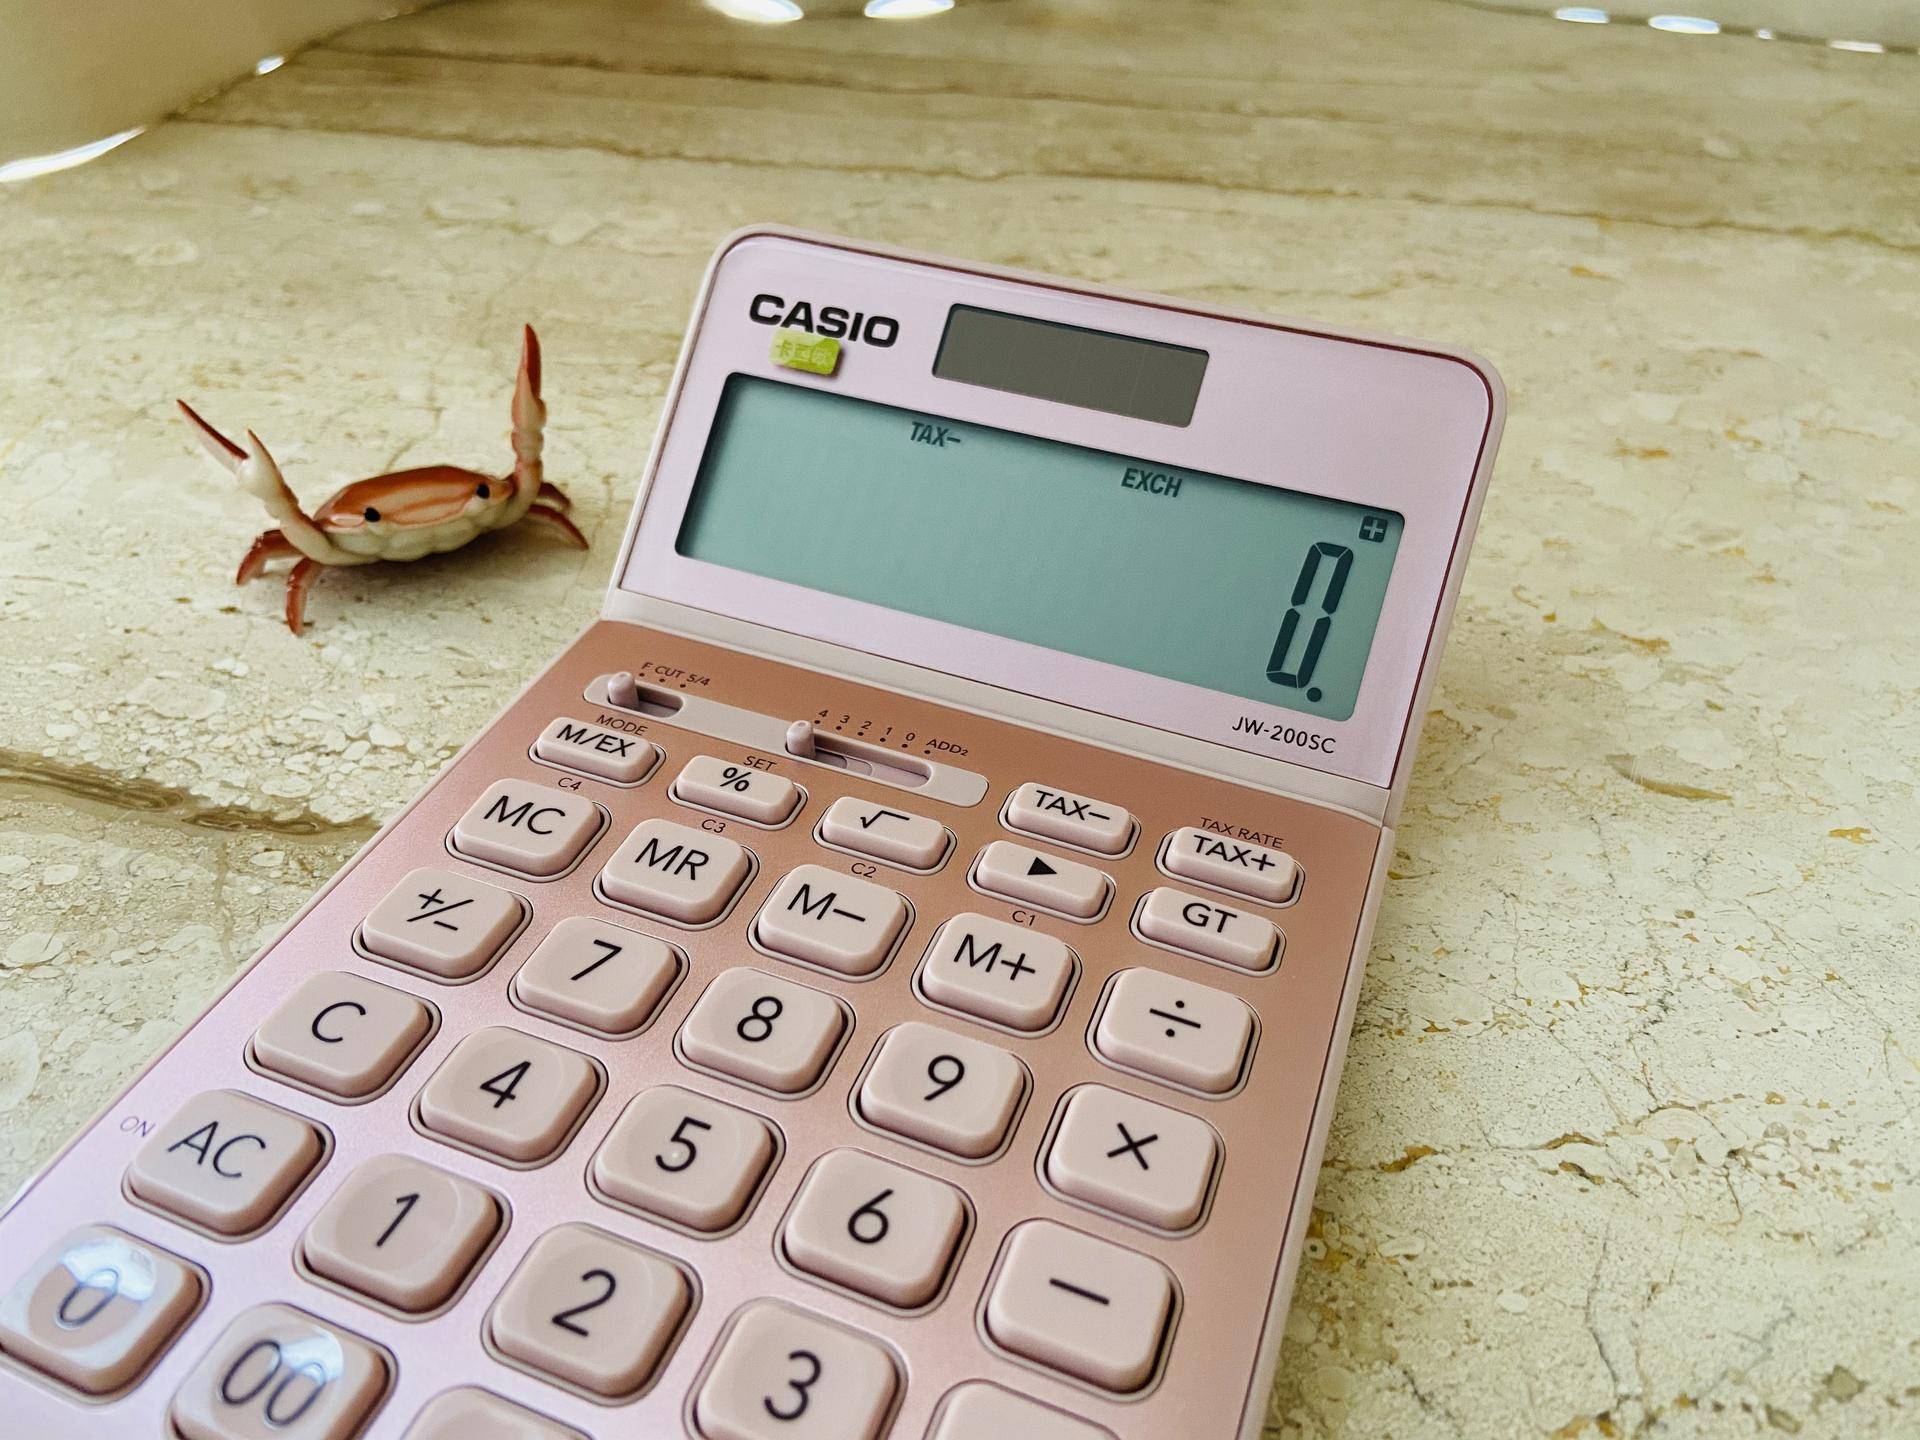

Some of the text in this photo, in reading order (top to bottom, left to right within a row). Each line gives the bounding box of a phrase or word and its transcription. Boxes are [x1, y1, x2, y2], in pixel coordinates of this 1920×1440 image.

[749, 293, 899, 348] CASIO
[1121, 468, 1182, 499] EXCH
[642, 661, 710, 687] F CUT 5/4
[556, 723, 636, 758] M/EX
[596, 714, 648, 737] MODE
[818, 709, 828, 719] 4
[840, 715, 849, 725] 3
[861, 720, 871, 730] 2
[886, 726, 892, 736] 1
[906, 732, 915, 742] 0
[1231, 716, 1336, 754] JW-200SC
[722, 767, 749, 793] %
[743, 755, 777, 773] SET
[558, 777, 583, 793] C4
[485, 795, 566, 836] MC
[701, 819, 727, 834] C3
[1201, 817, 1284, 850] TAX RATE
[635, 838, 709, 881] MR
[851, 863, 877, 879] C2
[1193, 834, 1276, 872] TAX+
[1012, 910, 1036, 927] C1
[1182, 902, 1237, 934] GT
[570, 939, 622, 982] 7
[953, 934, 1036, 982] M+
[311, 1001, 366, 1043] C
[737, 996, 784, 1042] 8
[479, 1061, 531, 1109] 4
[924, 1055, 966, 1101] 9
[120, 1115, 156, 1138] ON
[655, 1116, 712, 1172] 5
[166, 1120, 266, 1179] AC
[375, 1193, 420, 1248] 1
[847, 1189, 894, 1244] 6
[58, 1267, 120, 1328] 0
[551, 1269, 616, 1337] 2
[220, 1339, 328, 1428] 00
[763, 1350, 822, 1421] 3
